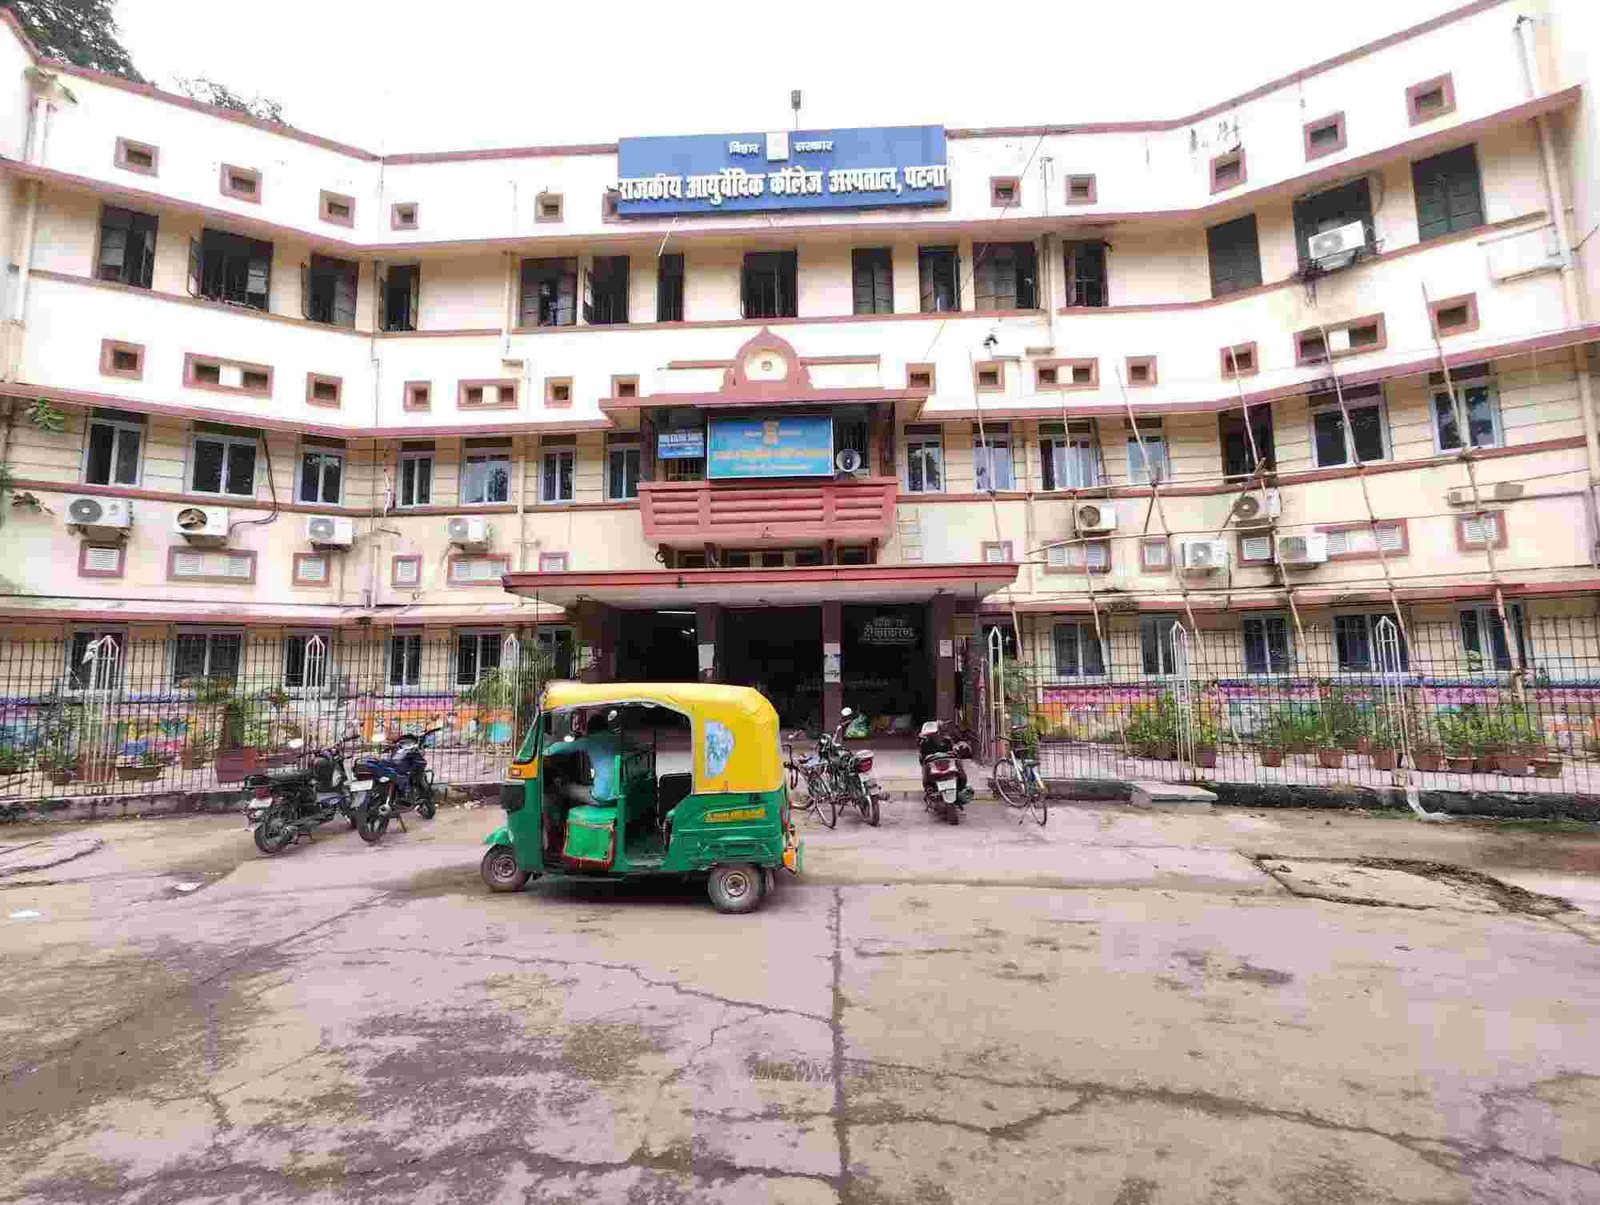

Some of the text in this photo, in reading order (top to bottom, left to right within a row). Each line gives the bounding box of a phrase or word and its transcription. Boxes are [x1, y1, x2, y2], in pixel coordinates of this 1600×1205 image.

[729, 141, 833, 154] बिहार सरकार
[618, 165, 947, 205] राजकीय आयुर्वेदिक कॉलेज अस्पताल, पटना
